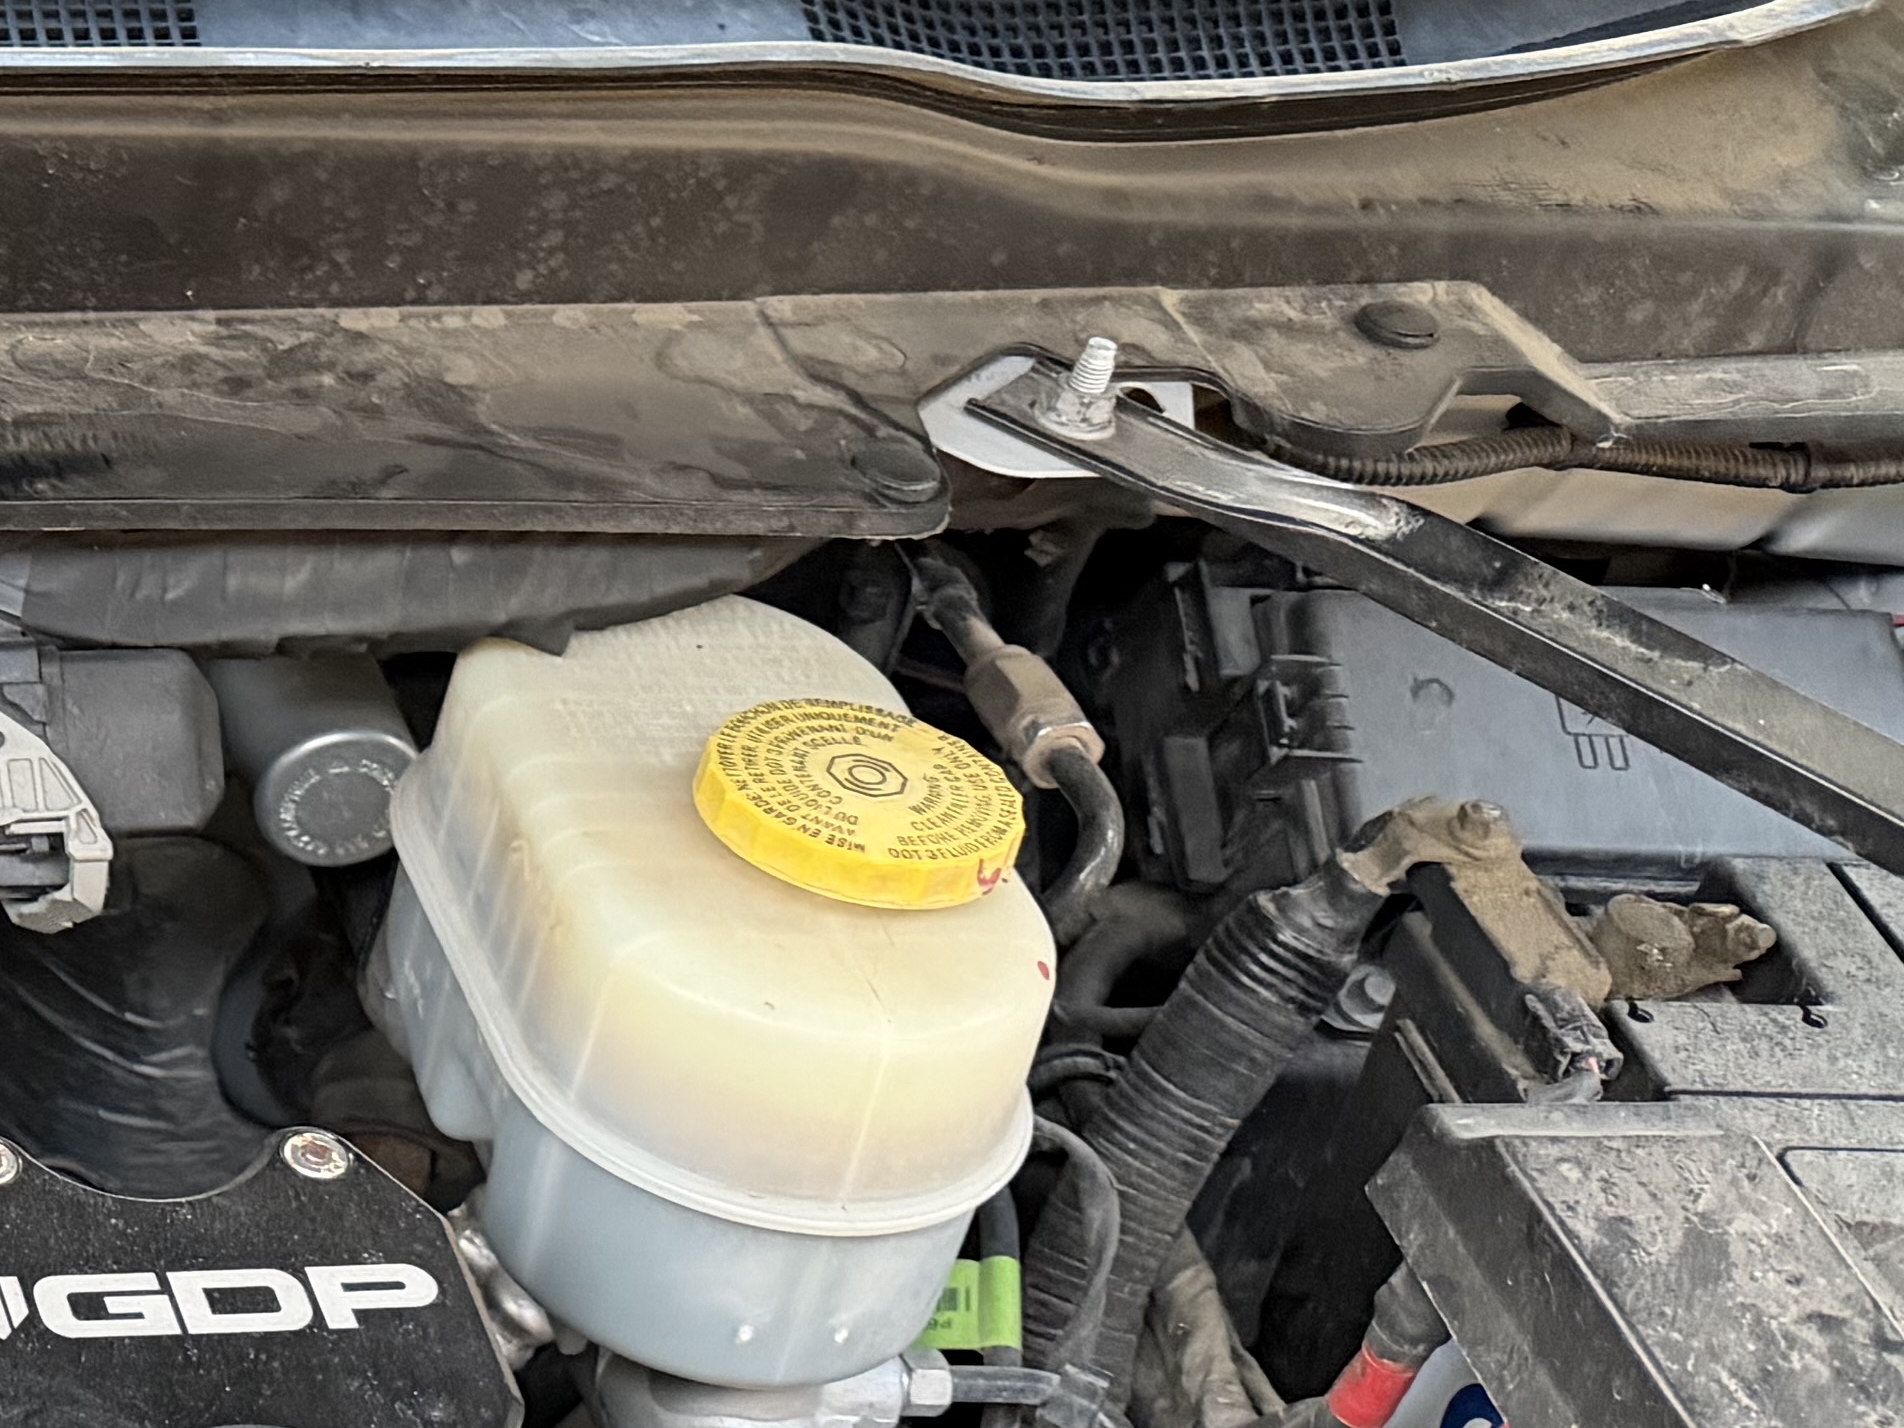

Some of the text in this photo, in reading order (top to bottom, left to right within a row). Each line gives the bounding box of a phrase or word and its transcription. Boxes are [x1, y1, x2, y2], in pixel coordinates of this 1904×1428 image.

[833, 810, 859, 826] DU
[796, 823, 822, 839] EN
[824, 833, 866, 853] MISE
[33, 1262, 439, 1340] GDP
